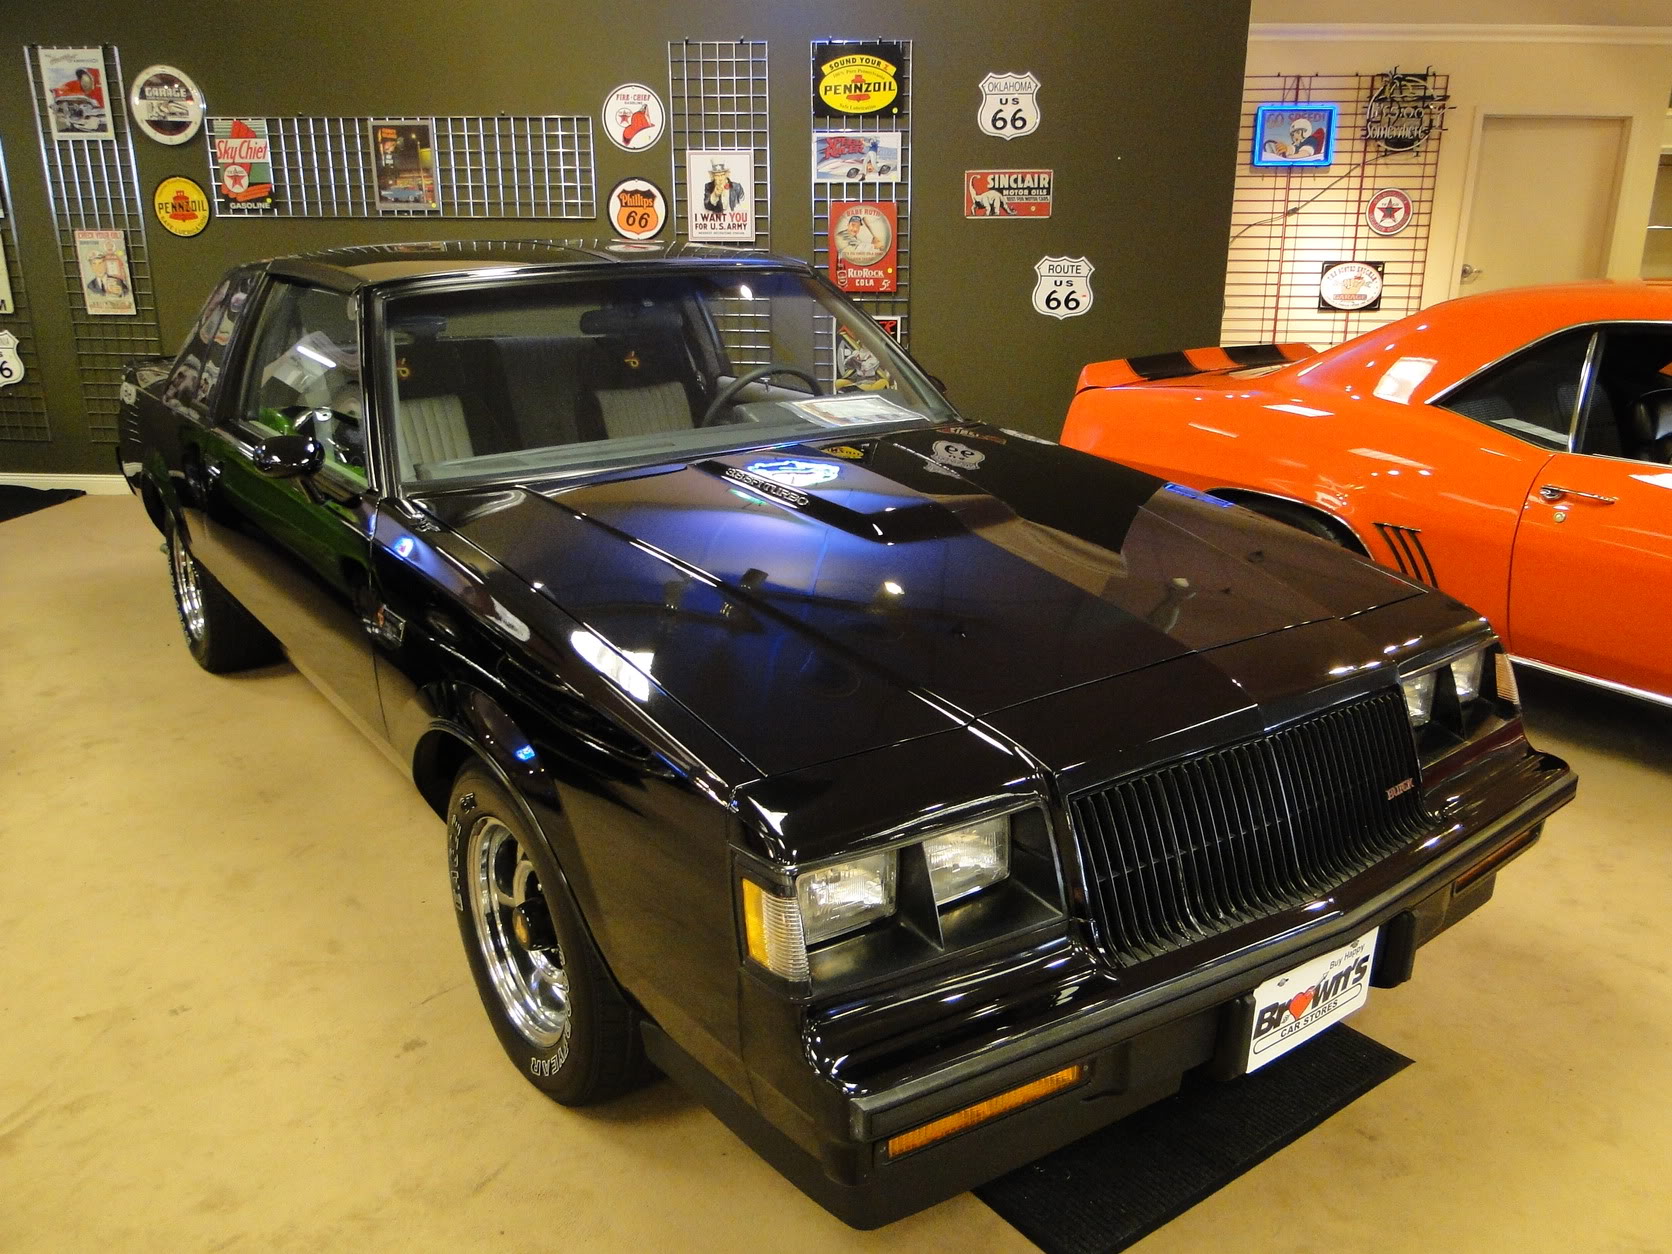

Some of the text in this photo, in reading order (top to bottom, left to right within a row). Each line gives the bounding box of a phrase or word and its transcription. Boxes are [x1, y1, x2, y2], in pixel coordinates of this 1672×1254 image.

[829, 57, 857, 71] SOUND
[860, 57, 882, 67] YOUR
[145, 87, 187, 98] GARAGE
[824, 81, 895, 96] PENNZOIL
[988, 81, 1032, 92] OKLAHOMA
[991, 108, 1027, 131] 66
[217, 140, 268, 164] Sky Chief
[987, 174, 1049, 189] SINCLAIR
[158, 200, 207, 214] PENNZOIL
[230, 202, 271, 210] GASOLINE
[619, 193, 654, 209] Phillips
[626, 210, 650, 228] 66
[694, 212, 748, 222] I WANT YOU
[1048, 264, 1082, 274] ROUTE
[1045, 290, 1080, 310] 66
[764, 481, 809, 506] TURBO
[1385, 777, 1415, 801] BUICK
[1329, 943, 1365, 969] Buy Happy
[1280, 999, 1338, 1038] CAR STORES
